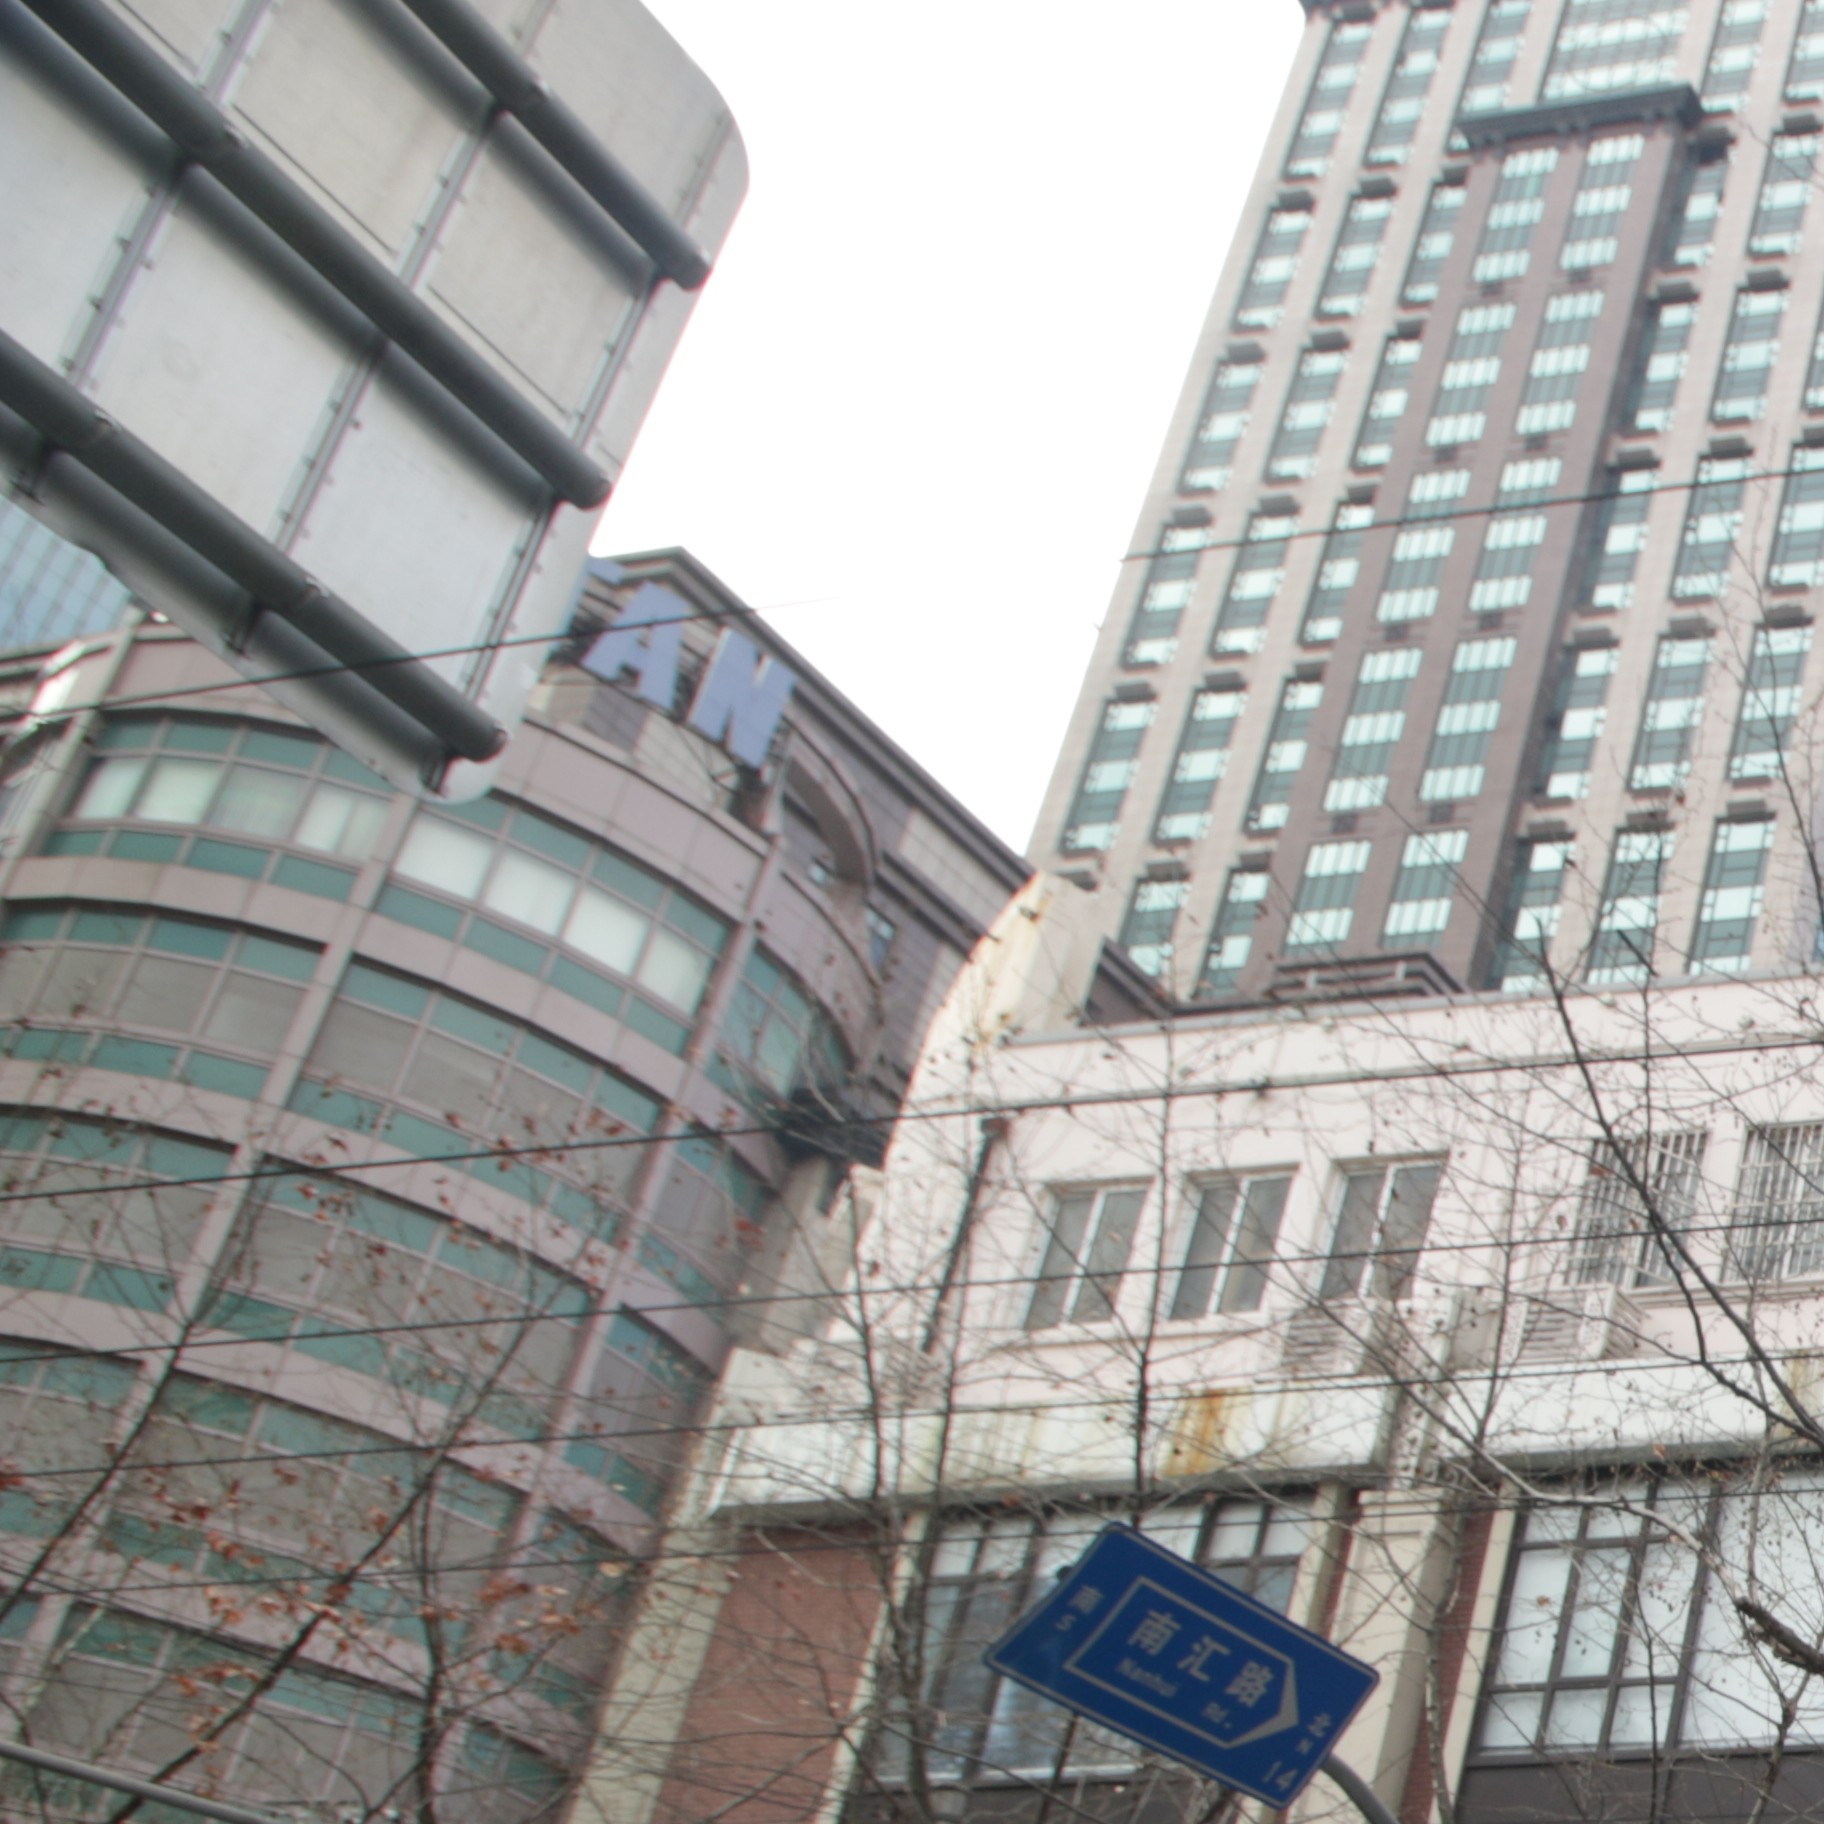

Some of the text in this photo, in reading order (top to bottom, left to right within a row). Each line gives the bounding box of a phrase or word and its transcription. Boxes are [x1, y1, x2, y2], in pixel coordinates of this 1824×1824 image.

[1127, 1608, 1275, 1708] 南汇路
[1306, 1711, 1332, 1739] 北
[1261, 1761, 1299, 1792] 14
